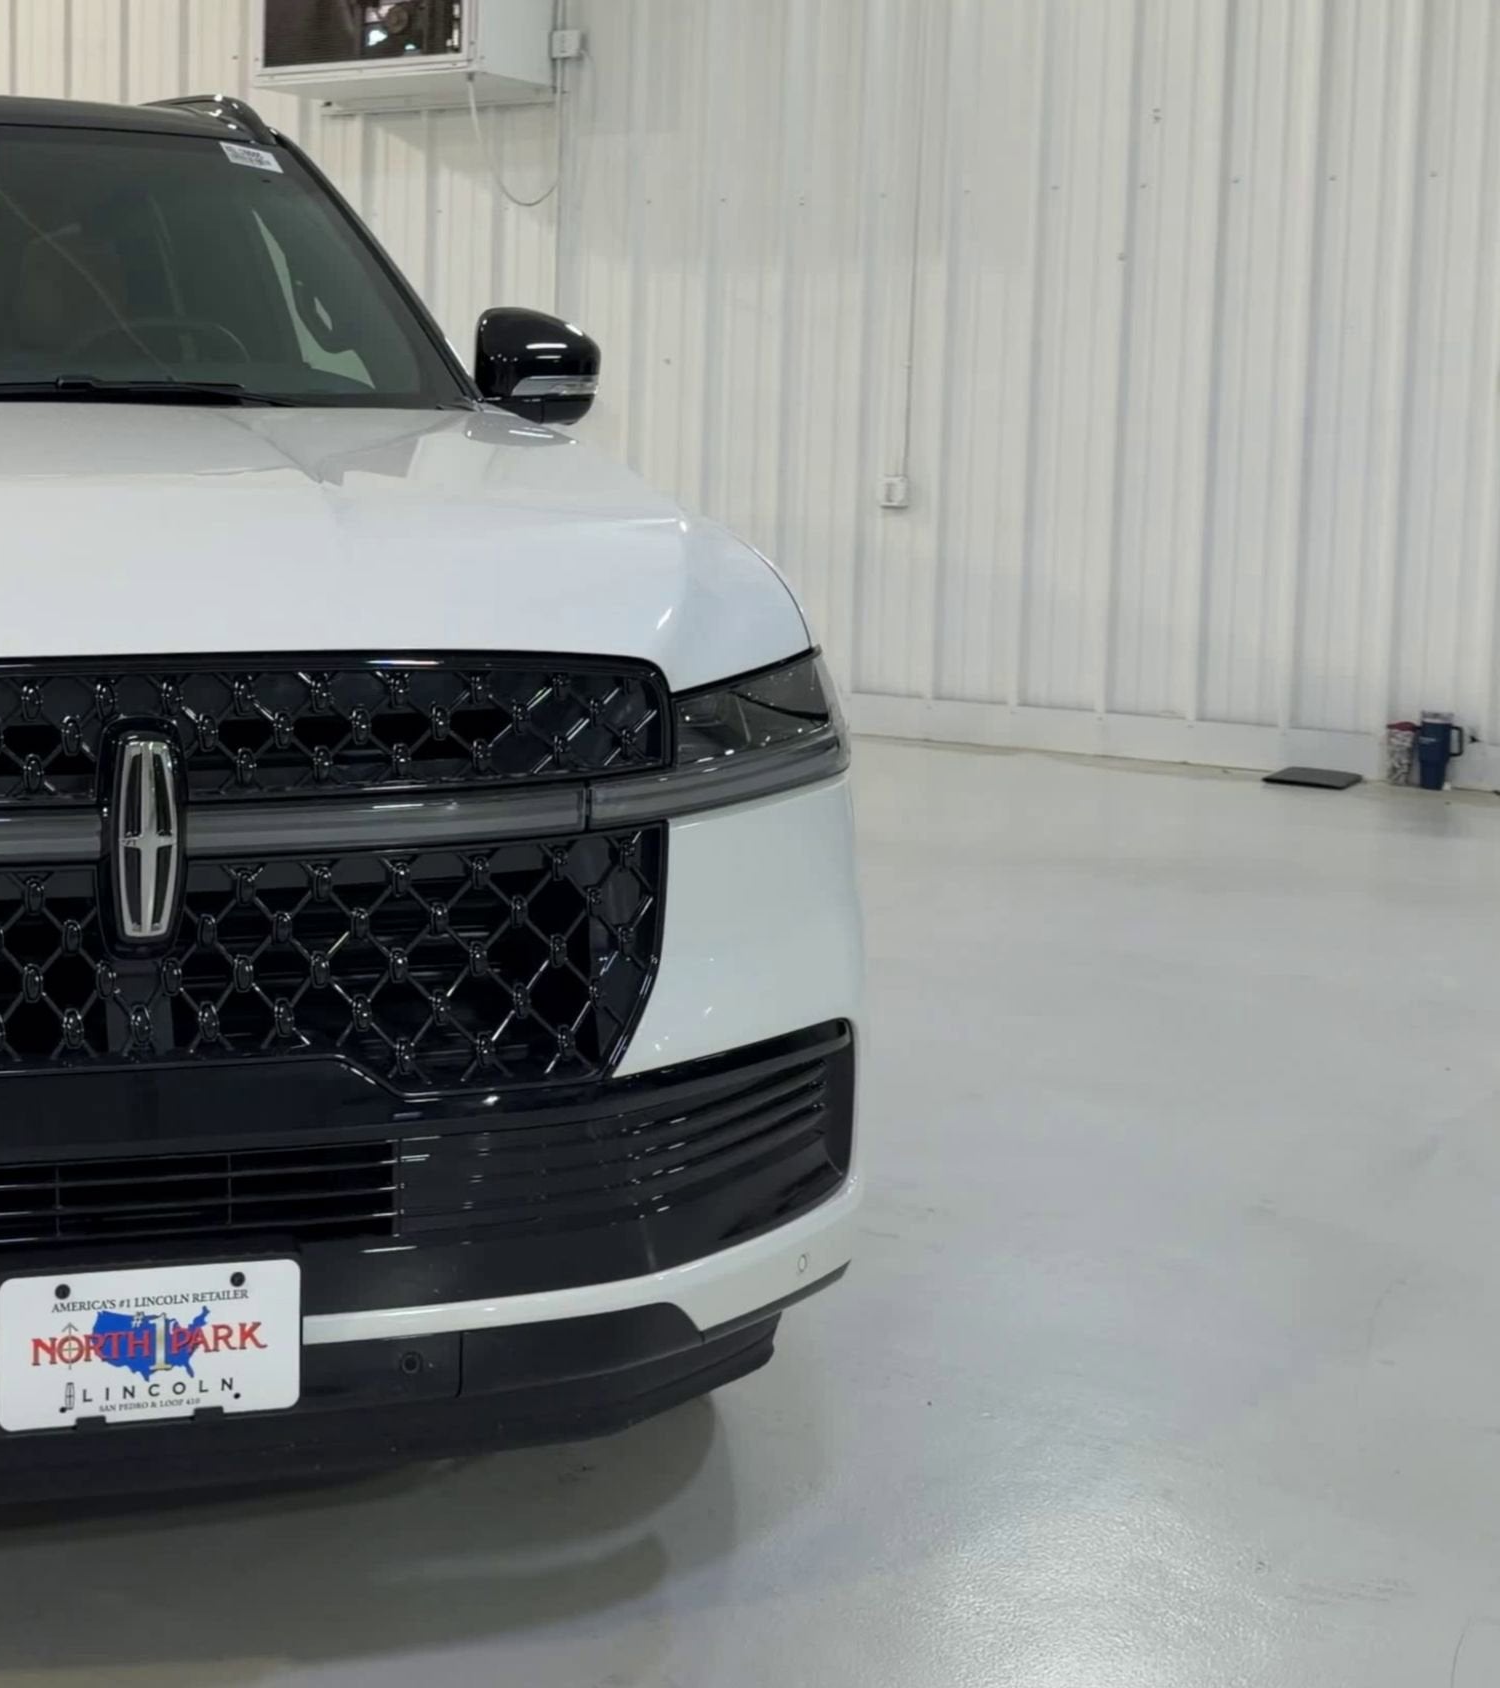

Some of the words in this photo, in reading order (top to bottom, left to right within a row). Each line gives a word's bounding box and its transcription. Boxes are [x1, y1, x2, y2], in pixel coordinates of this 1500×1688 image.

[52, 1299, 117, 1313] AMERICA'S
[134, 1293, 190, 1308] LINCOLN
[192, 1289, 249, 1303] RETAILER
[31, 1329, 150, 1366] NORTH
[170, 1321, 268, 1356] PARK
[82, 1377, 234, 1403] LINCOLN
[100, 1401, 117, 1413] SAN
[118, 1399, 149, 1411] PEDRO
[159, 1398, 184, 1407] LOOP
